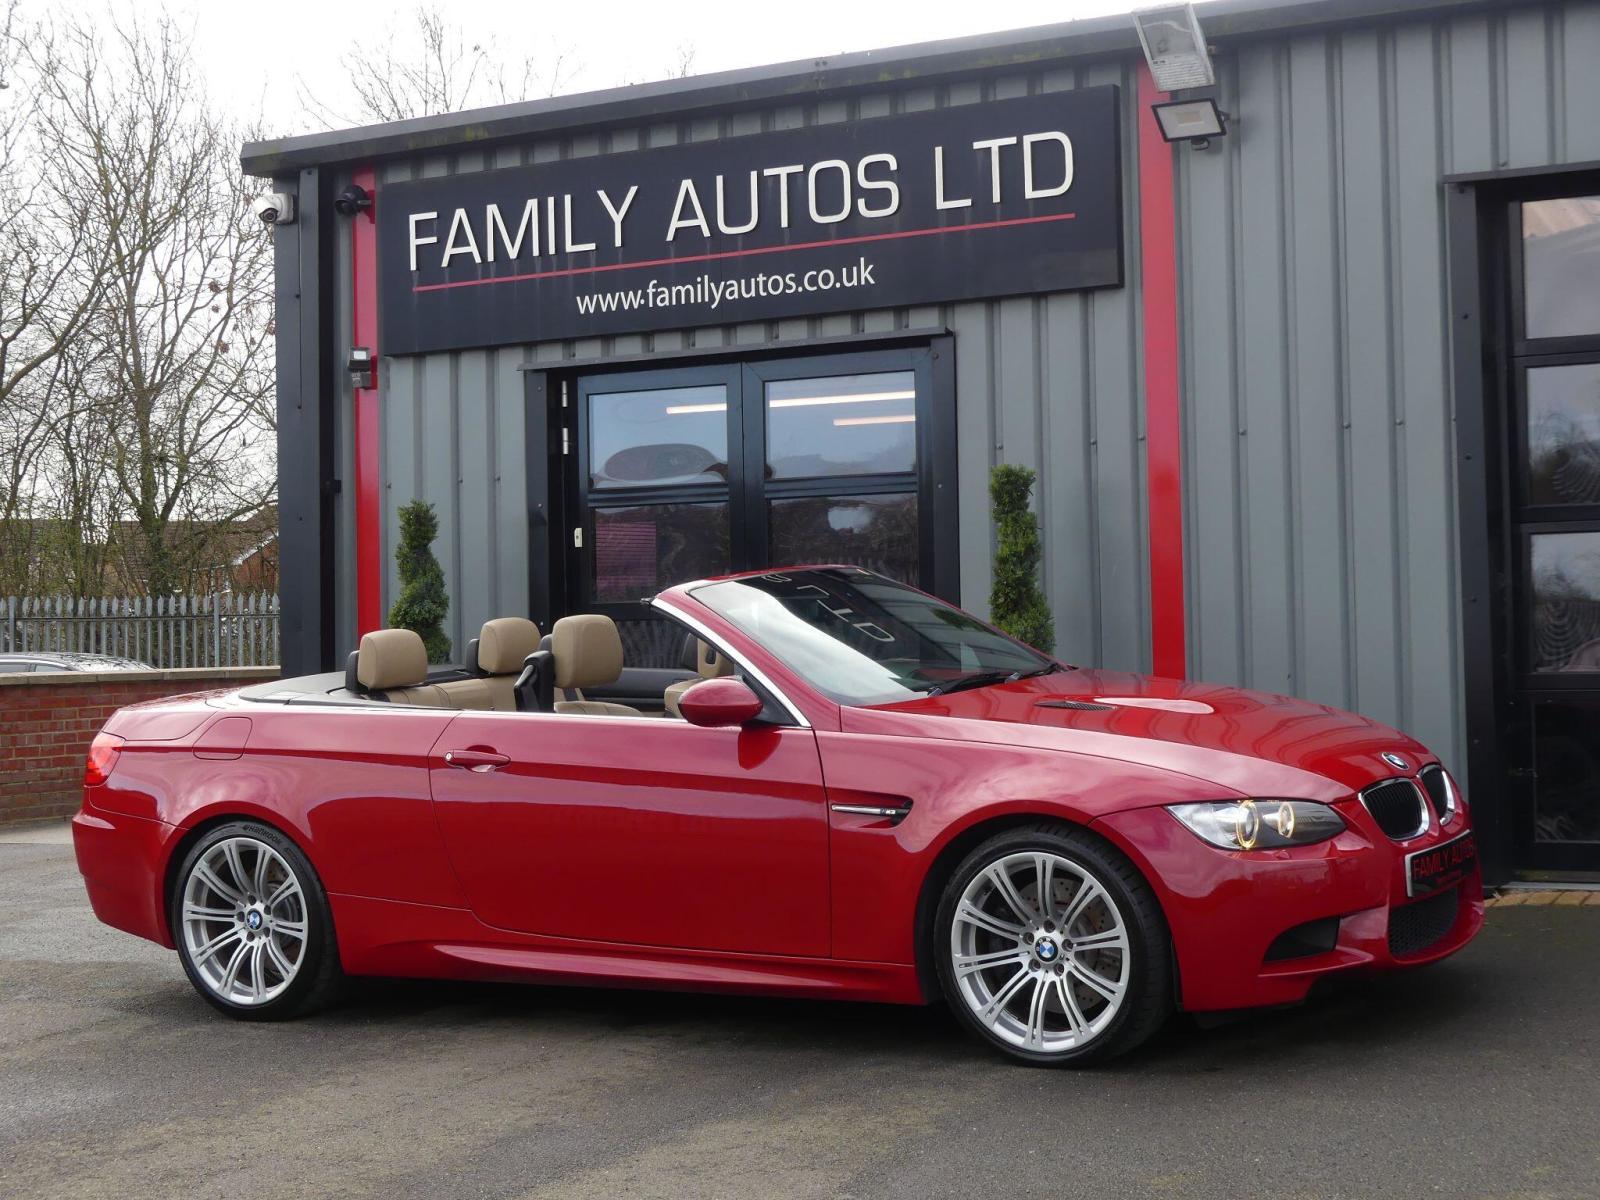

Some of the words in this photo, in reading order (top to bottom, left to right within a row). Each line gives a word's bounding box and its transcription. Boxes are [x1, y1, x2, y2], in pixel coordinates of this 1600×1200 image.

[408, 185, 639, 272] FAMILY
[665, 153, 900, 242] AUTOS
[934, 130, 1074, 210] LTD
[576, 257, 876, 315] www.familyautos.co.uk
[1413, 848, 1449, 880] FAMILY
